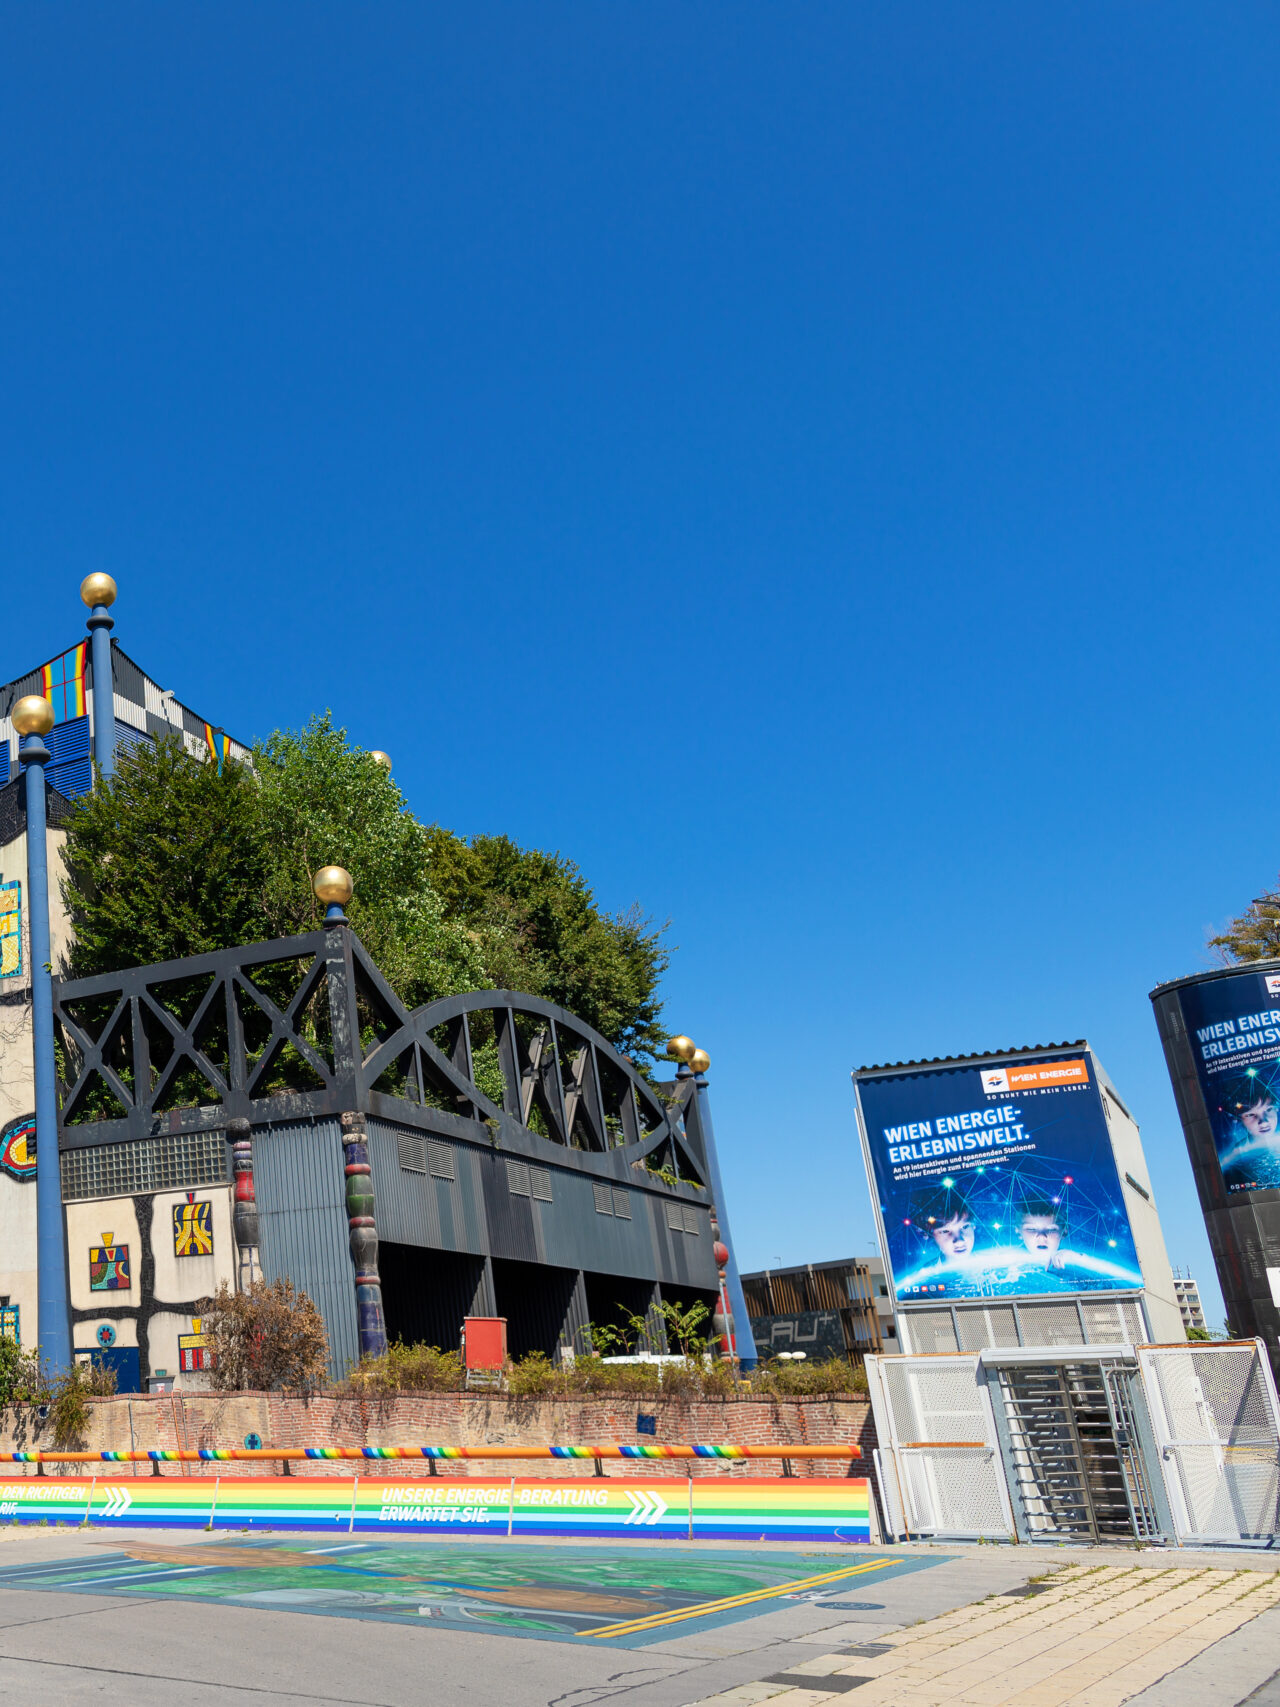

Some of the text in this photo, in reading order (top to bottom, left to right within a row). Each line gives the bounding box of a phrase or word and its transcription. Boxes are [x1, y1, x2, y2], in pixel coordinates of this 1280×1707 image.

[1196, 1020, 1236, 1043] WIEN
[1251, 1048, 1263, 1056] und
[1228, 1058, 1249, 1069] Energie
[1011, 1067, 1082, 1083] WIEN ENERGIE
[1000, 1091, 1020, 1099] BUNT
[1022, 1089, 1037, 1097] WIE
[1040, 1086, 1060, 1095] MEIN
[1063, 1083, 1091, 1092] LEBEN.
[884, 1105, 1021, 1144] WIEN ENERGIE-
[888, 1124, 1030, 1163] ERLEBNISWELT.
[910, 1159, 949, 1171] interaktiven
[949, 1155, 962, 1163] und
[963, 1149, 1003, 1162] spannenden
[1003, 1143, 1036, 1154] Stationen
[894, 1156, 1010, 1181] wird hier Energie zum Familienevent.
[5, 1486, 25, 1500] DEN
[25, 1486, 86, 1500] RICHTIGEN
[381, 1487, 444, 1504] UNSERE
[378, 1505, 491, 1523] ERWARTET SIE.
